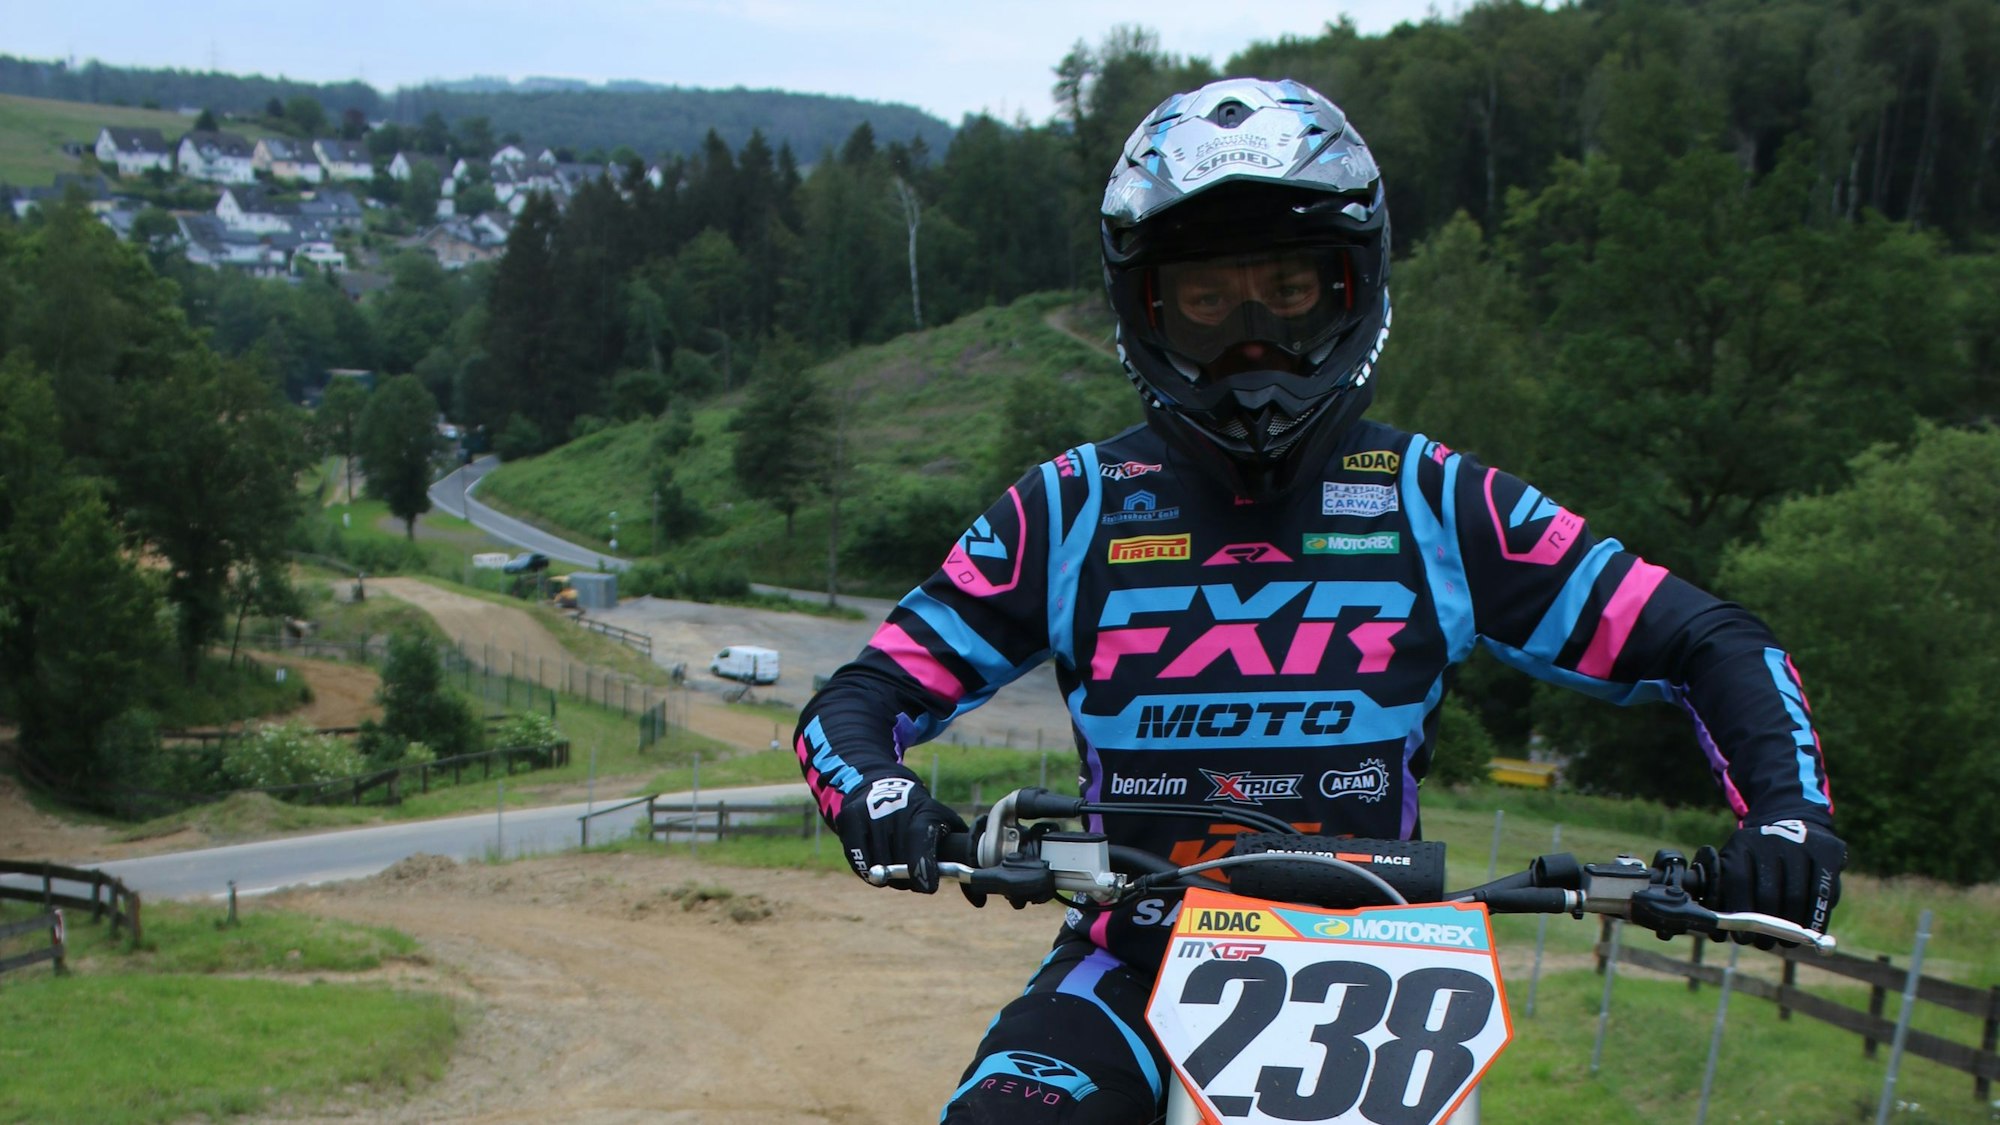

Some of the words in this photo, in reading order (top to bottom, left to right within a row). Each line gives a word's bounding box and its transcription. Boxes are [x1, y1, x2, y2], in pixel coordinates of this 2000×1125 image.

[1196, 152, 1268, 175] SHOEI
[1346, 453, 1397, 472] ADAC
[1324, 495, 1397, 510] CARWASH
[1111, 538, 1187, 560] PIRELLI
[1328, 536, 1394, 550] MOTOREX
[1091, 581, 1417, 680] FXR
[1136, 701, 1356, 739] MOTO
[1111, 773, 1188, 796] benzim
[1213, 774, 1296, 802] XTRIG
[1331, 773, 1375, 791] AFAM
[1373, 854, 1411, 866] RACE
[1197, 911, 1261, 932] ADAC
[1353, 919, 1475, 947] MOTOREX
[1177, 940, 1266, 962] MXGP
[1179, 955, 1495, 1125] 238
[980, 1078, 1060, 1105] REVO
